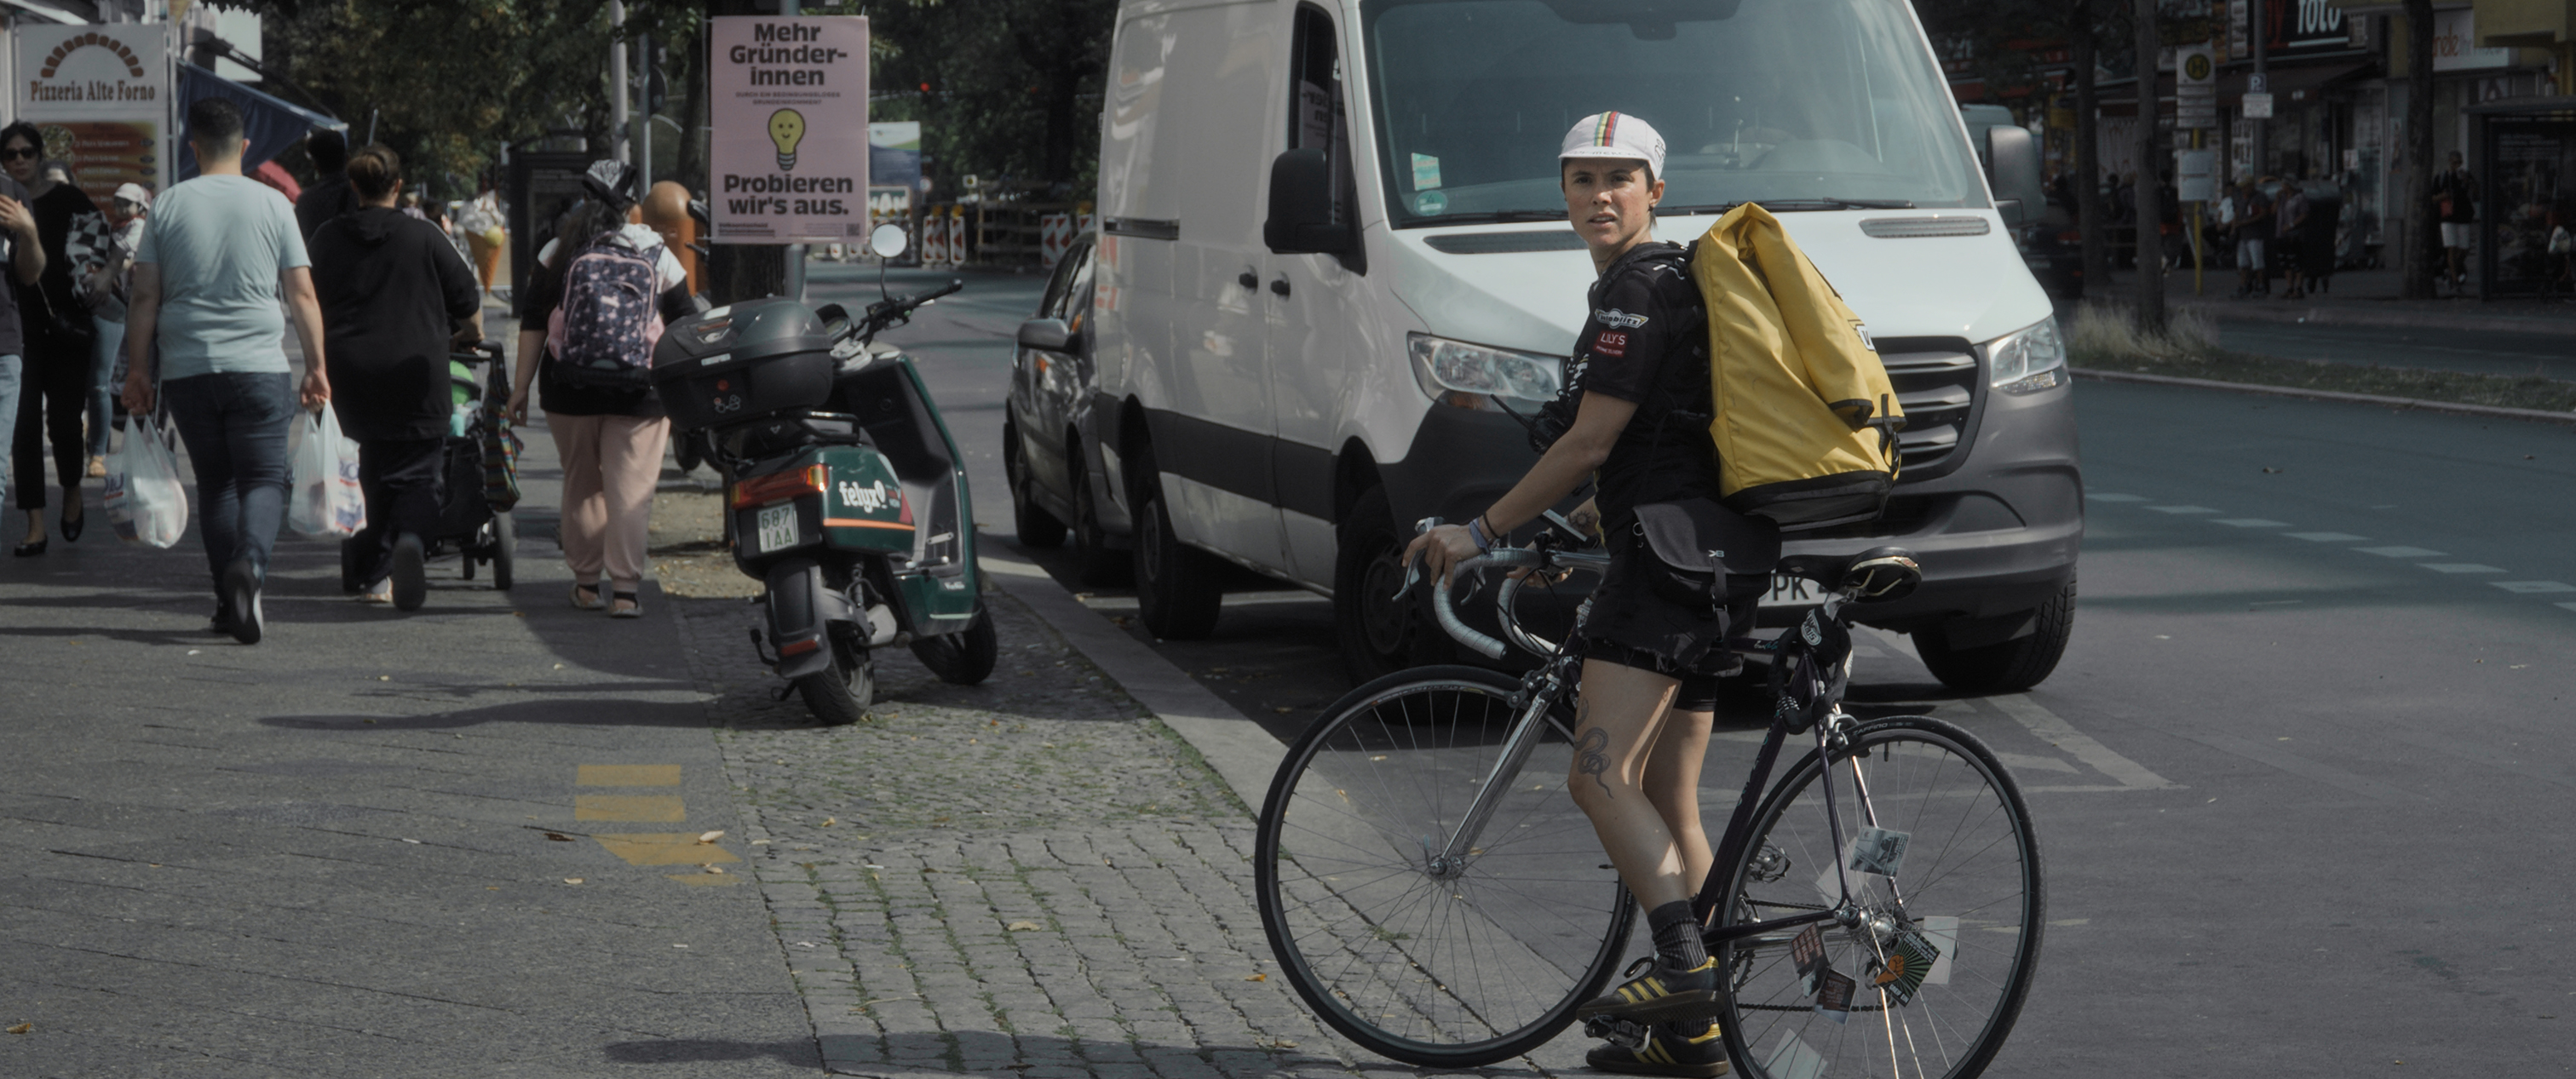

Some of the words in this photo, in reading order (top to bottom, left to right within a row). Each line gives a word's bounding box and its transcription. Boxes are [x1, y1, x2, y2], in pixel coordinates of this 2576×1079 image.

[754, 23, 821, 43] Mehr
[729, 43, 848, 65] Gründer-
[750, 66, 825, 86] innen
[31, 80, 83, 101] Pizzeria
[86, 80, 114, 101] Alte
[118, 80, 155, 101] Forno
[724, 174, 853, 193] Probieren
[727, 195, 787, 215] wir's
[793, 199, 848, 215] aus.
[761, 507, 791, 530] 687
[1773, 575, 1810, 601] PK
